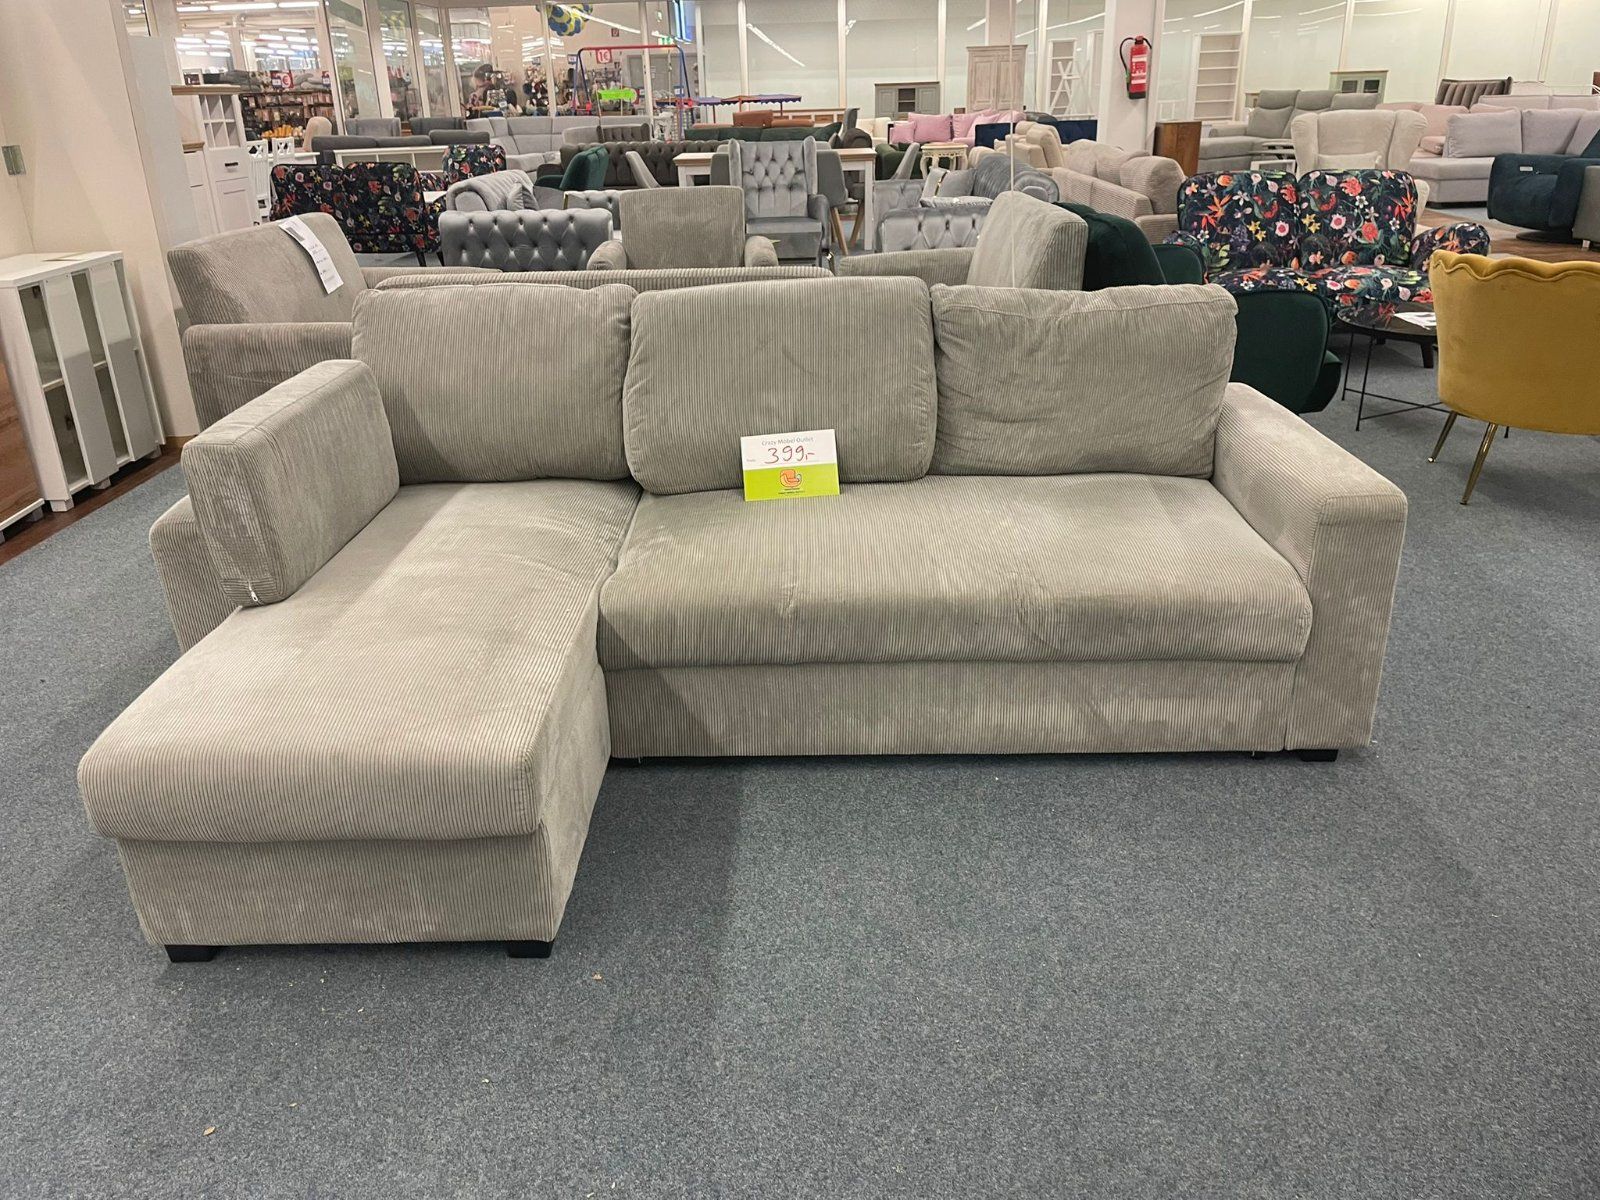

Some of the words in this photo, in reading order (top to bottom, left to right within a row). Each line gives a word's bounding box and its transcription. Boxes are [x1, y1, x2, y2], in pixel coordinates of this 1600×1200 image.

[598, 51, 609, 62] 1€
[761, 439, 776, 447] Crazy
[796, 435, 814, 443] Outlet
